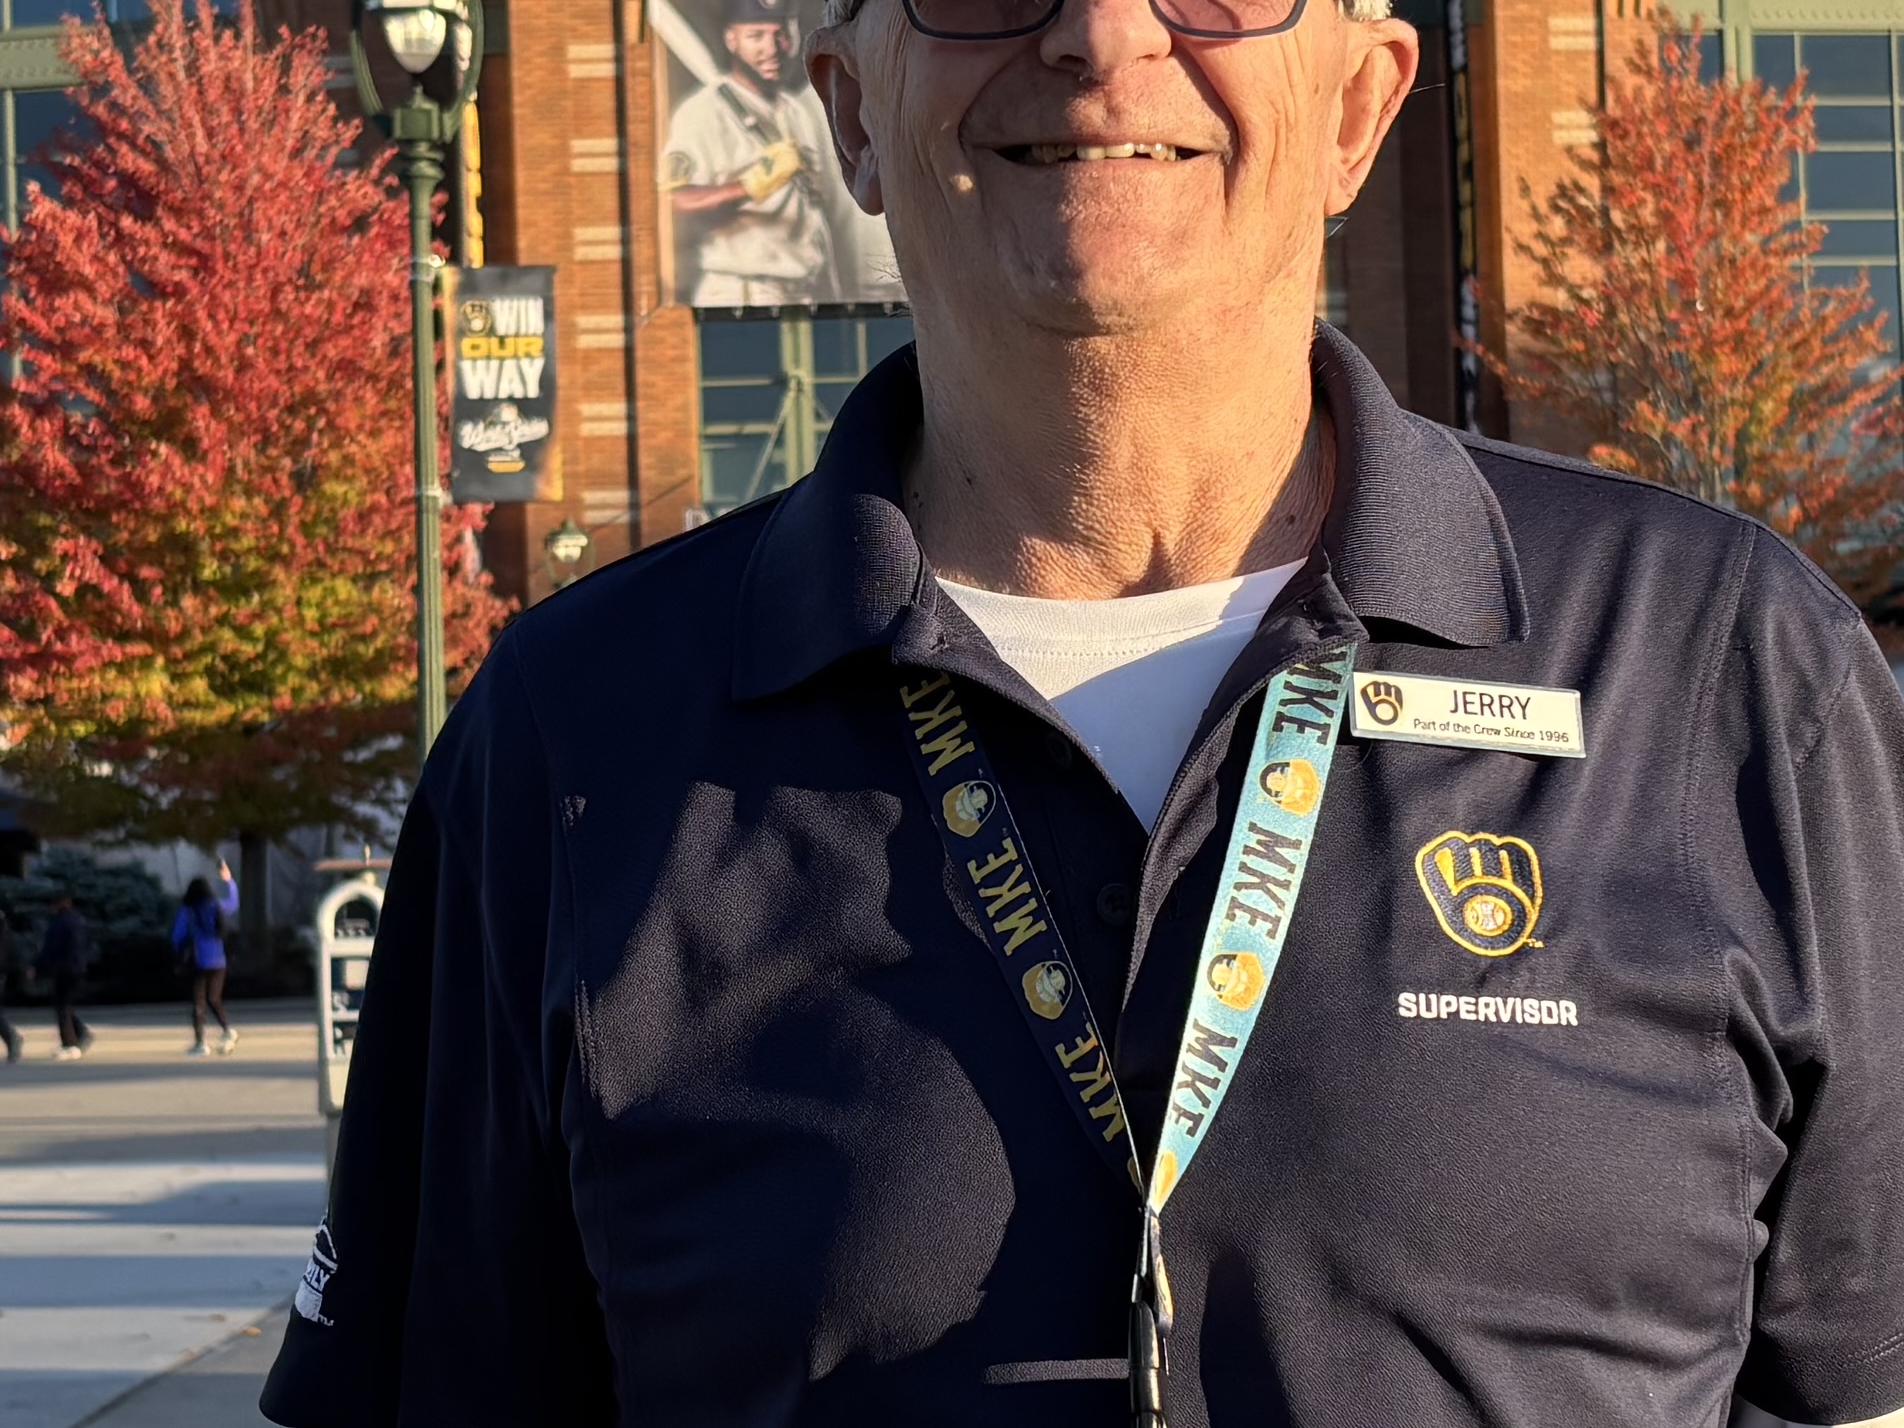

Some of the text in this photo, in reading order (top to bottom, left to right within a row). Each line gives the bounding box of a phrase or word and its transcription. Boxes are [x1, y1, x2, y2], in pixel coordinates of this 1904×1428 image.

[492, 296, 546, 337] WIN
[460, 335, 545, 360] OUR
[460, 357, 546, 401] WAY
[1449, 689, 1532, 721] JERRY
[1413, 718, 1570, 743] Part of the Crew Since 1996
[966, 836, 1048, 957] MKE
[1226, 820, 1304, 941] MKE
[1397, 991, 1579, 1027] SUPERVISOR
